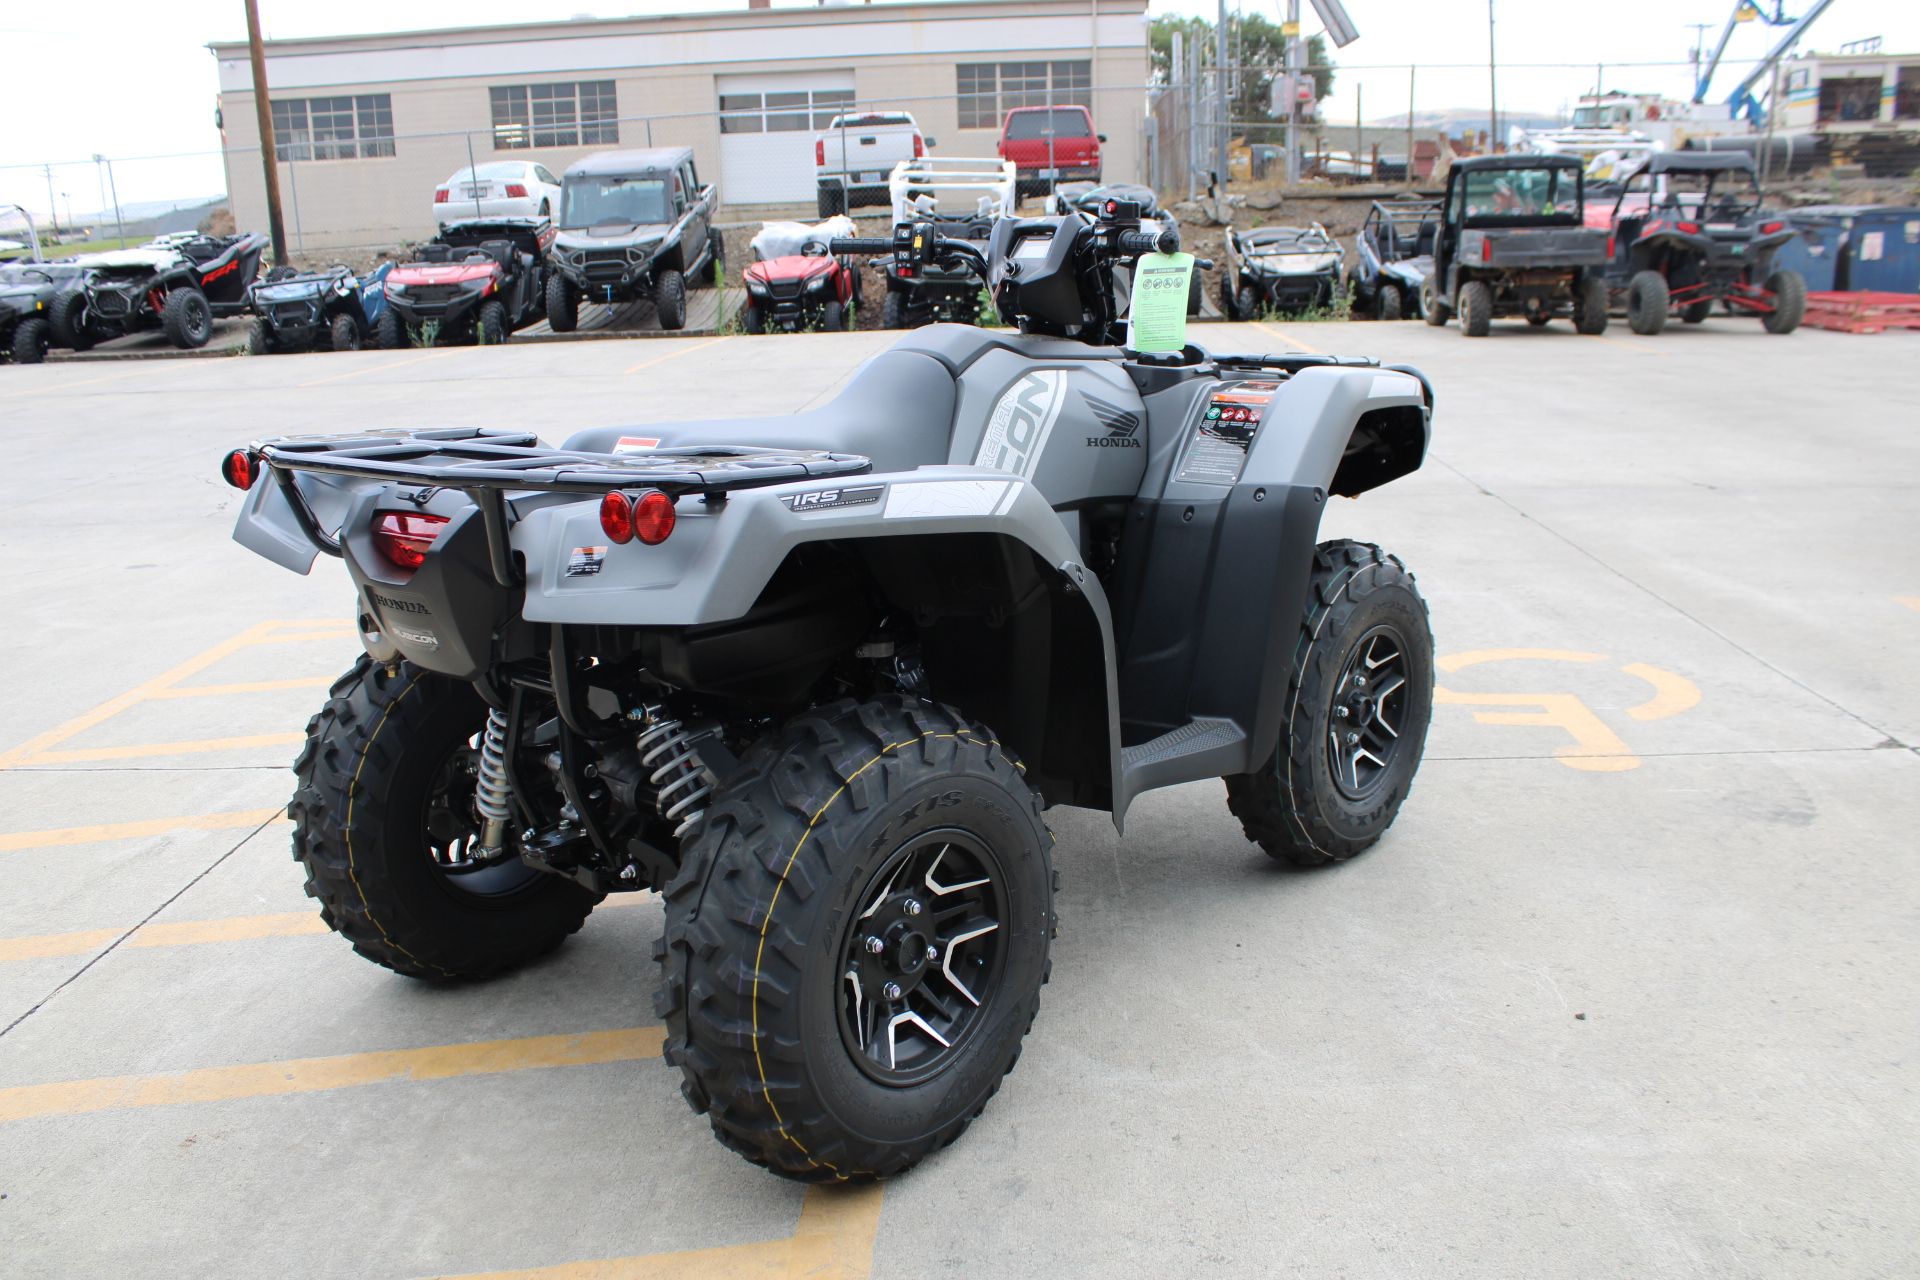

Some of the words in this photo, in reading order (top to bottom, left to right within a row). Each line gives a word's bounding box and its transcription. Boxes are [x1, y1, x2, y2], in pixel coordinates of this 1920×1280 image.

[1086, 437, 1141, 448] HONDA
[793, 489, 840, 506] IRS
[375, 594, 432, 615] HONDA
